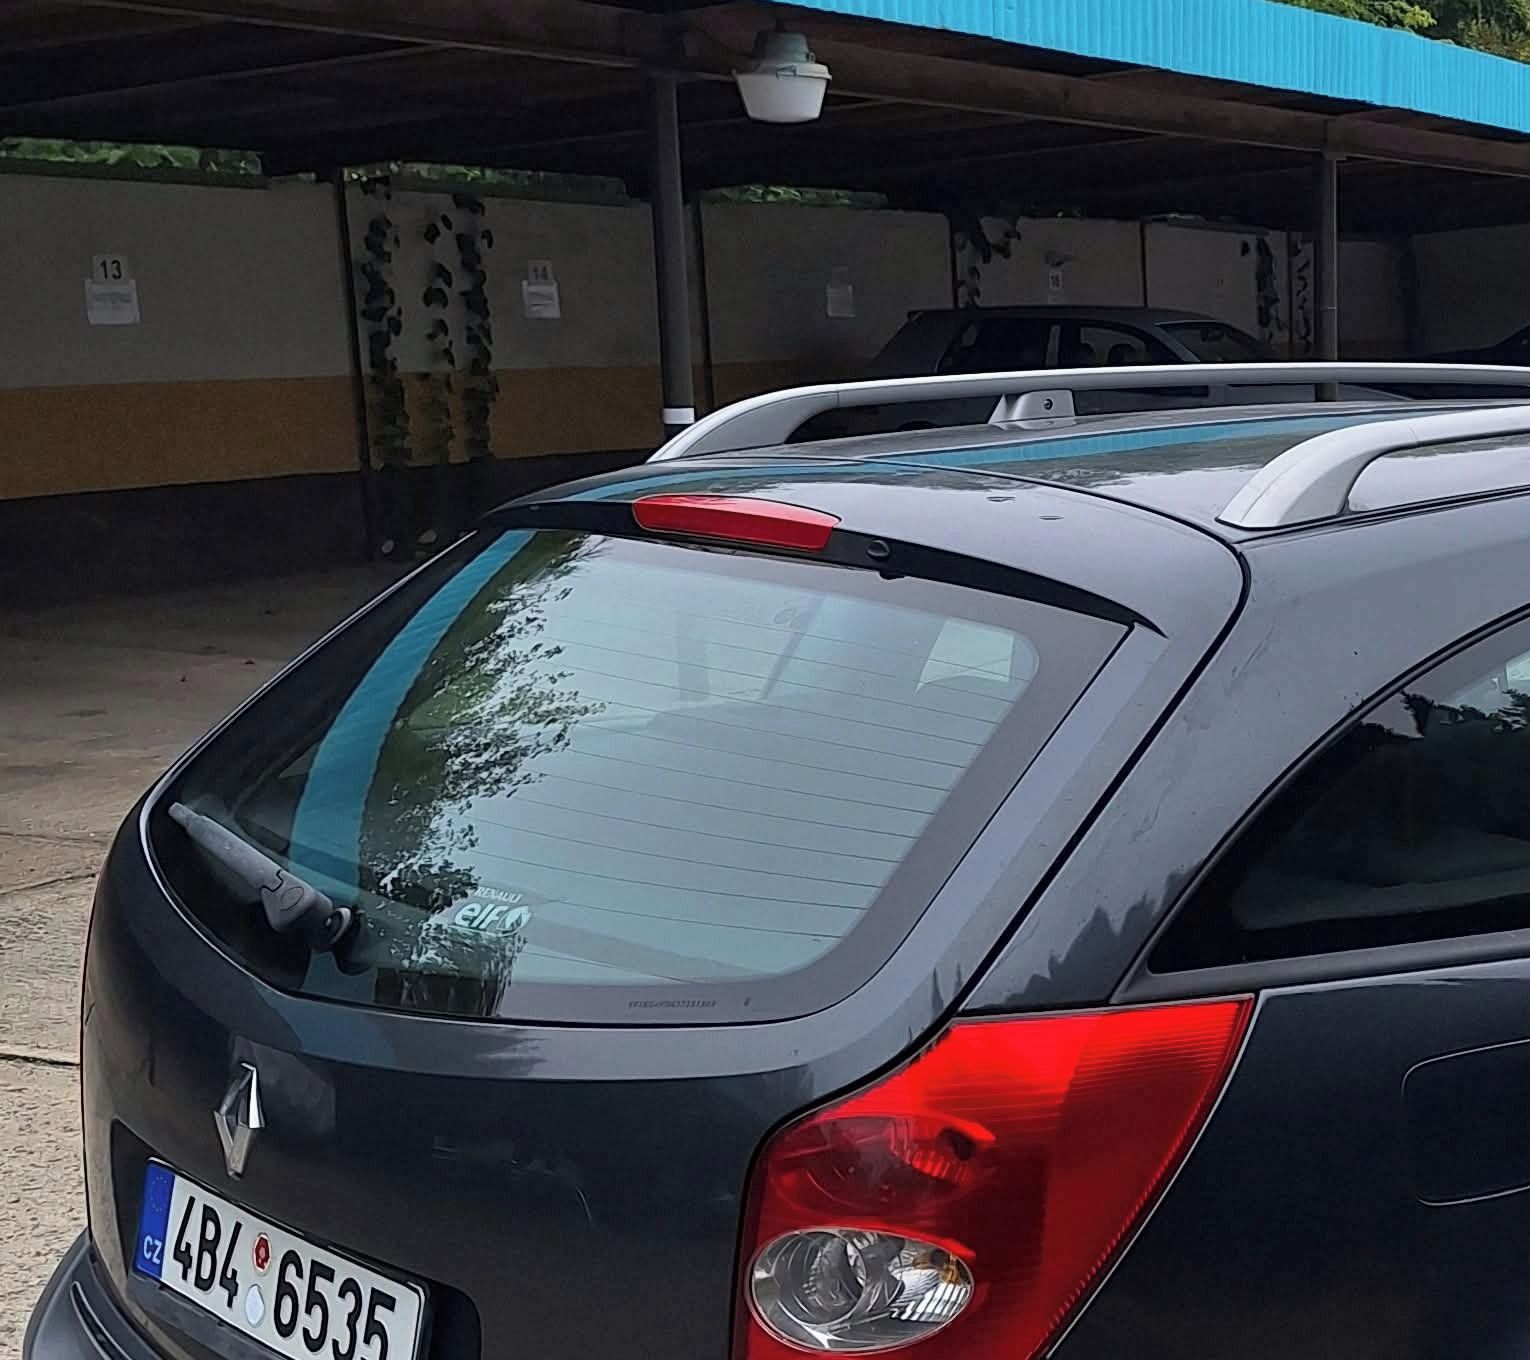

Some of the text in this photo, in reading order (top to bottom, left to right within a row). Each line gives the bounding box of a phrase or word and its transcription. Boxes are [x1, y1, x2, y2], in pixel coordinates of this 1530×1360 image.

[100, 259, 122, 279] 13
[475, 886, 523, 903] RENAULT
[455, 903, 509, 929] elf
[143, 1235, 161, 1265] CZ
[173, 1195, 243, 1309] 4B4
